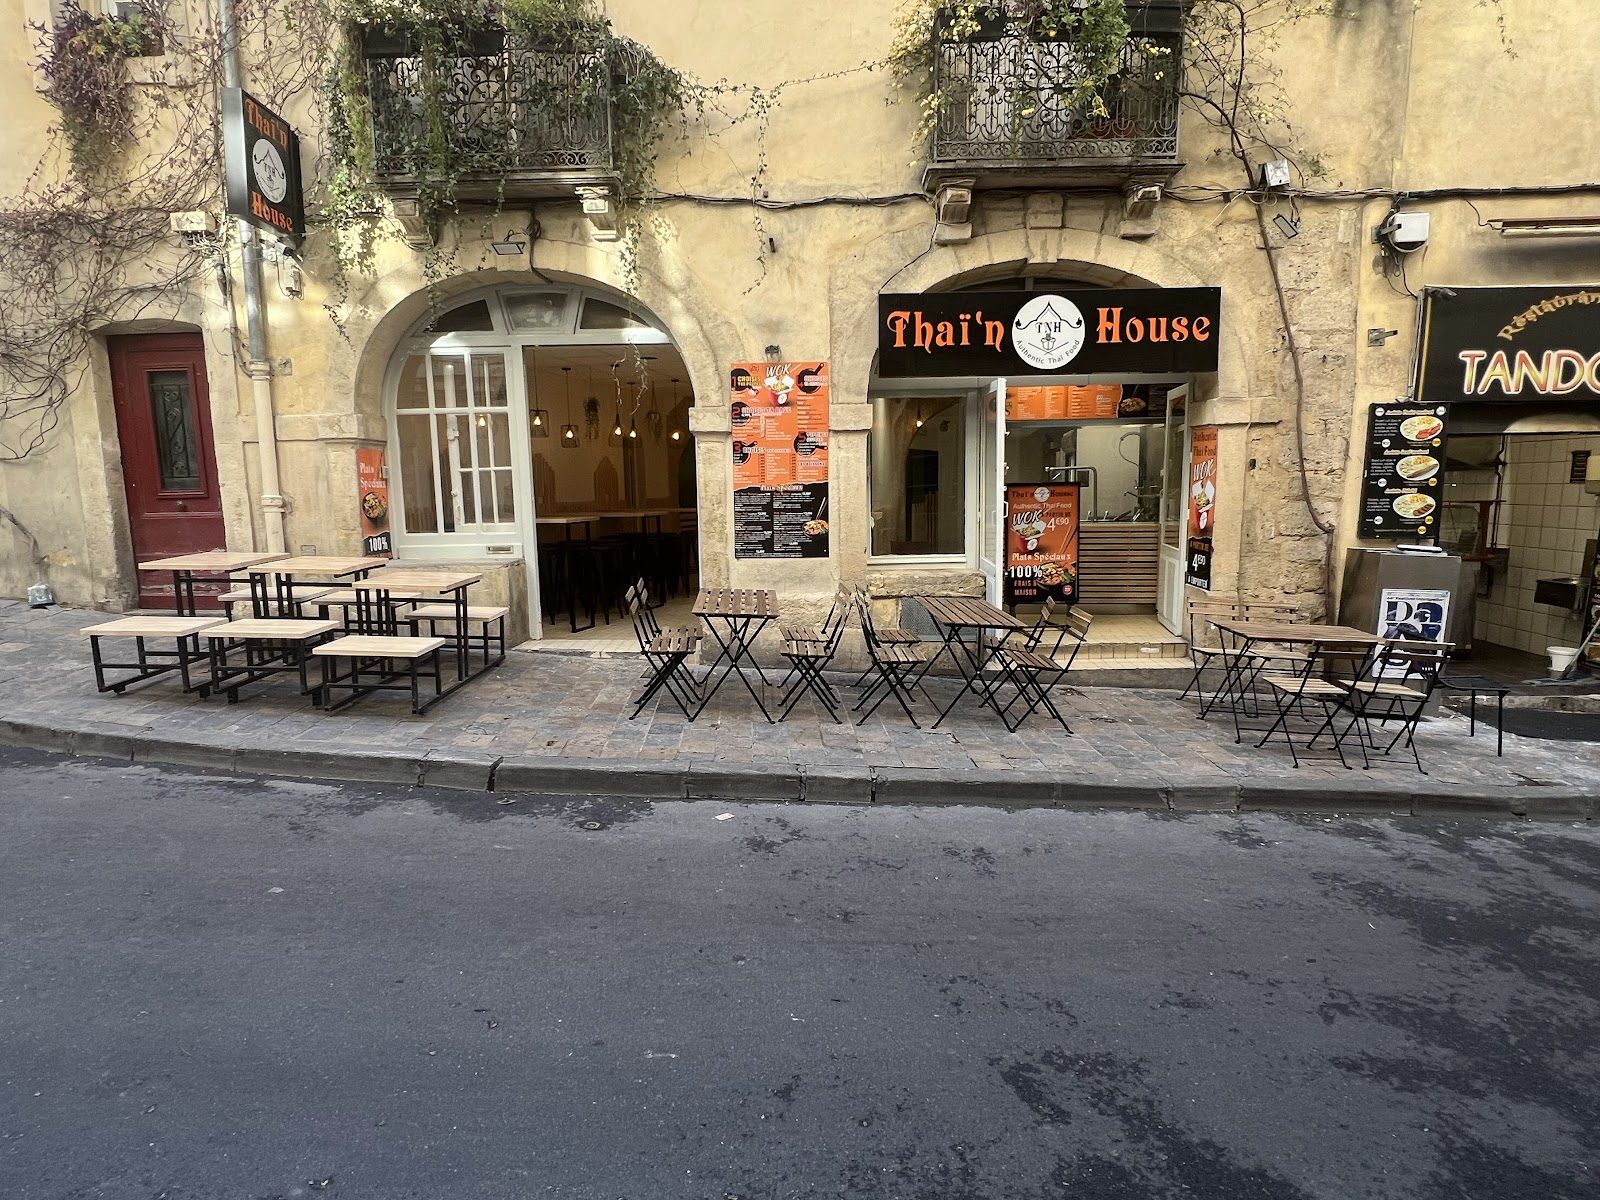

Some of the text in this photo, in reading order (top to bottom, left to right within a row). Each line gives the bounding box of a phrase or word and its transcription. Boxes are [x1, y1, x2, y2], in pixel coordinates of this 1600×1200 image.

[252, 190, 293, 232] House
[1035, 321, 1061, 334] TNH
[1096, 306, 1210, 343] House
[1016, 340, 1044, 364] Authentic
[1065, 340, 1080, 357] Food
[766, 364, 791, 377] WOK
[1193, 458, 1214, 481] WOK
[1013, 502, 1040, 510] Authentic
[1012, 509, 1042, 526] WOK
[369, 536, 388, 552] 100%
[1012, 552, 1071, 562] Plats Spéciaux
[1010, 565, 1043, 578] 100%
